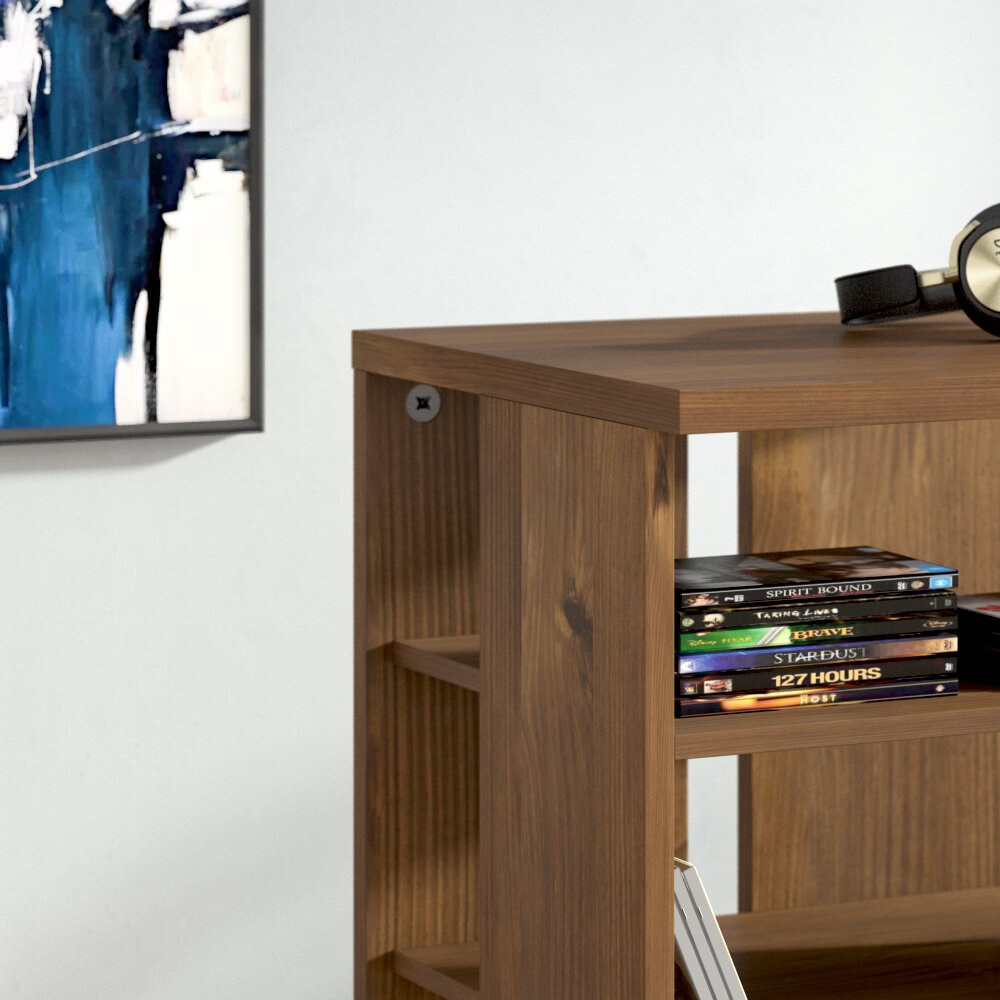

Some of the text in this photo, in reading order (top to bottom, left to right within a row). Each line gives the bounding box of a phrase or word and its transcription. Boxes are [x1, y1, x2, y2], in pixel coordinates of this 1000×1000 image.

[766, 587, 813, 599] SPIRIT
[817, 583, 873, 596] BOUND
[721, 635, 753, 644] PIXAR
[791, 626, 855, 641] BRAVE
[773, 647, 866, 665] STARDUST
[771, 667, 882, 687] 127 HOURS
